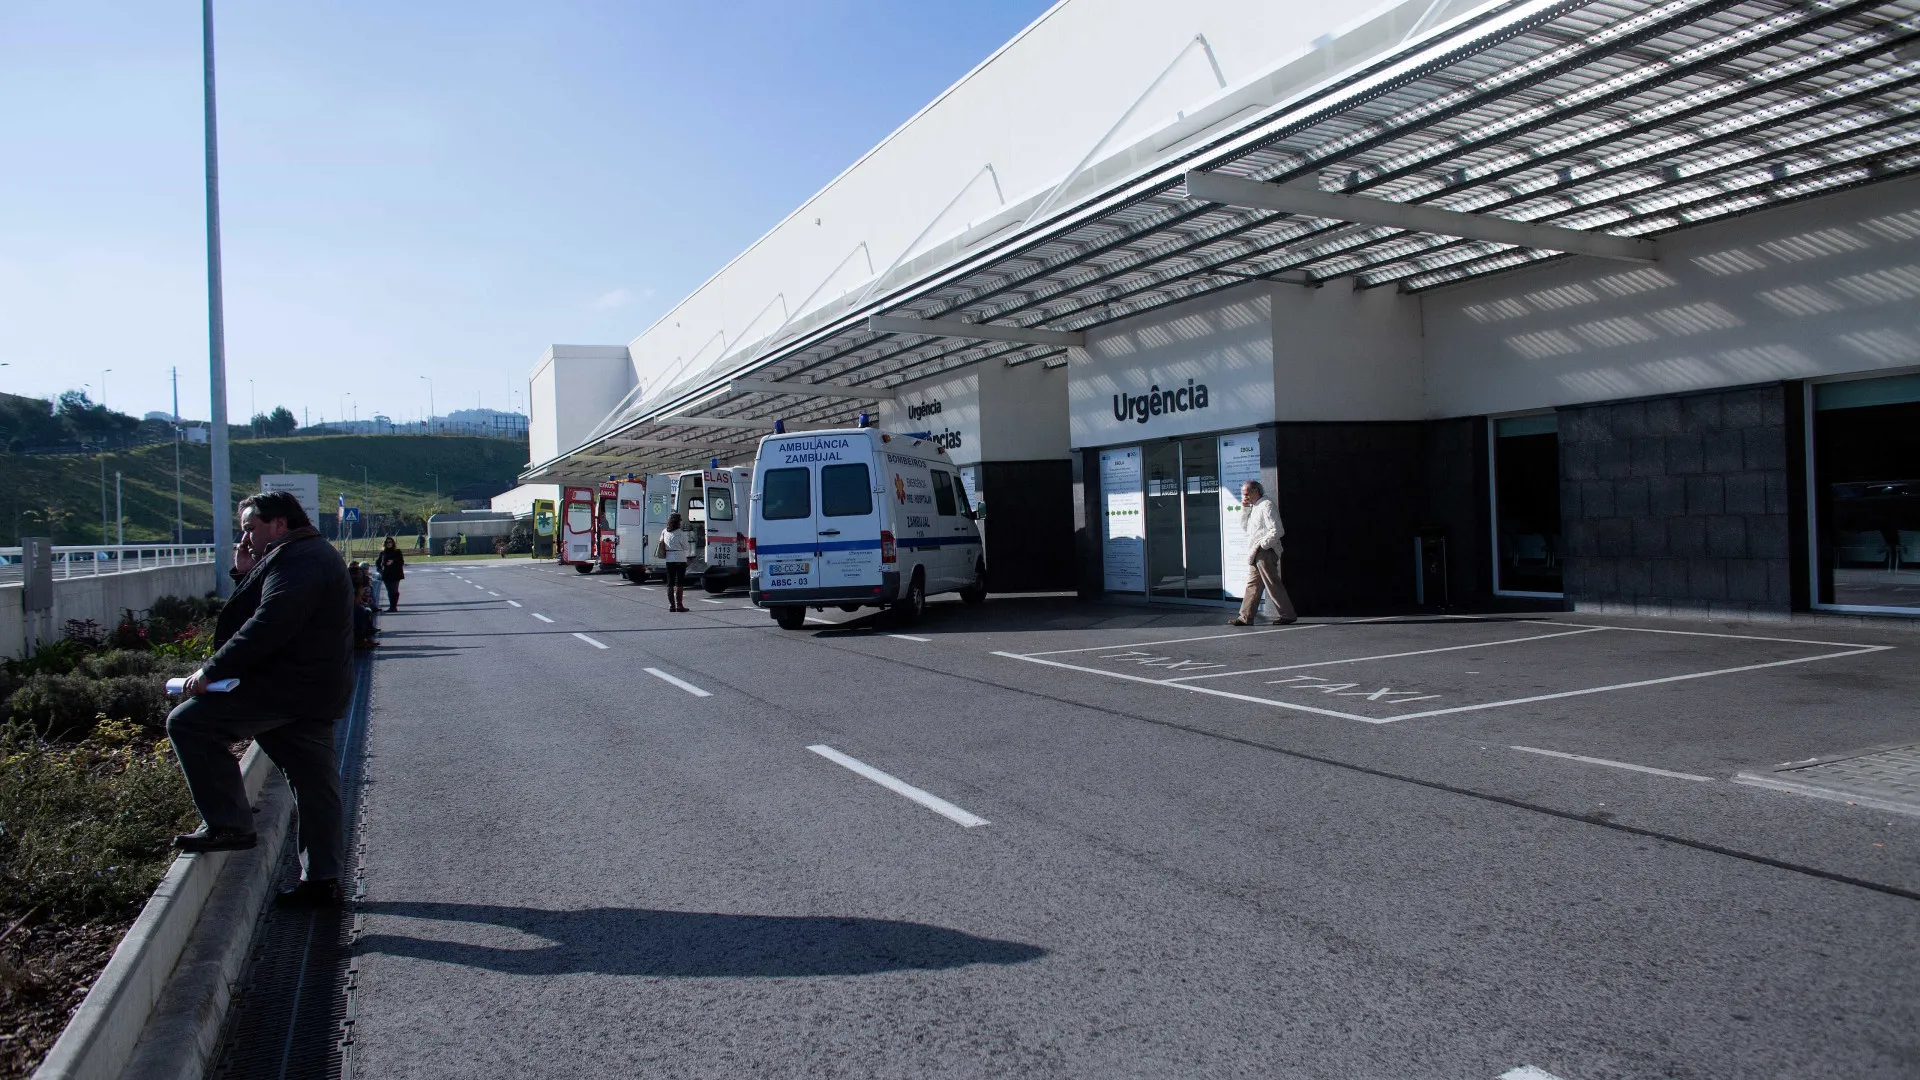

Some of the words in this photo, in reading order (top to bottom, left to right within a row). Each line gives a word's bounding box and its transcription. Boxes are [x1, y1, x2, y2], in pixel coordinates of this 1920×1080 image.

[908, 399, 942, 420] Urgência
[1113, 378, 1208, 424] Urgência
[778, 439, 850, 452] AMBULÂNCIA
[785, 452, 843, 464] ZAMBUJAL
[887, 454, 927, 468] BOMBEIROS
[771, 578, 792, 587] ABSC
[798, 578, 808, 586] 03
[1098, 651, 1226, 671] TAXI
[1265, 675, 1442, 704] TAXI
